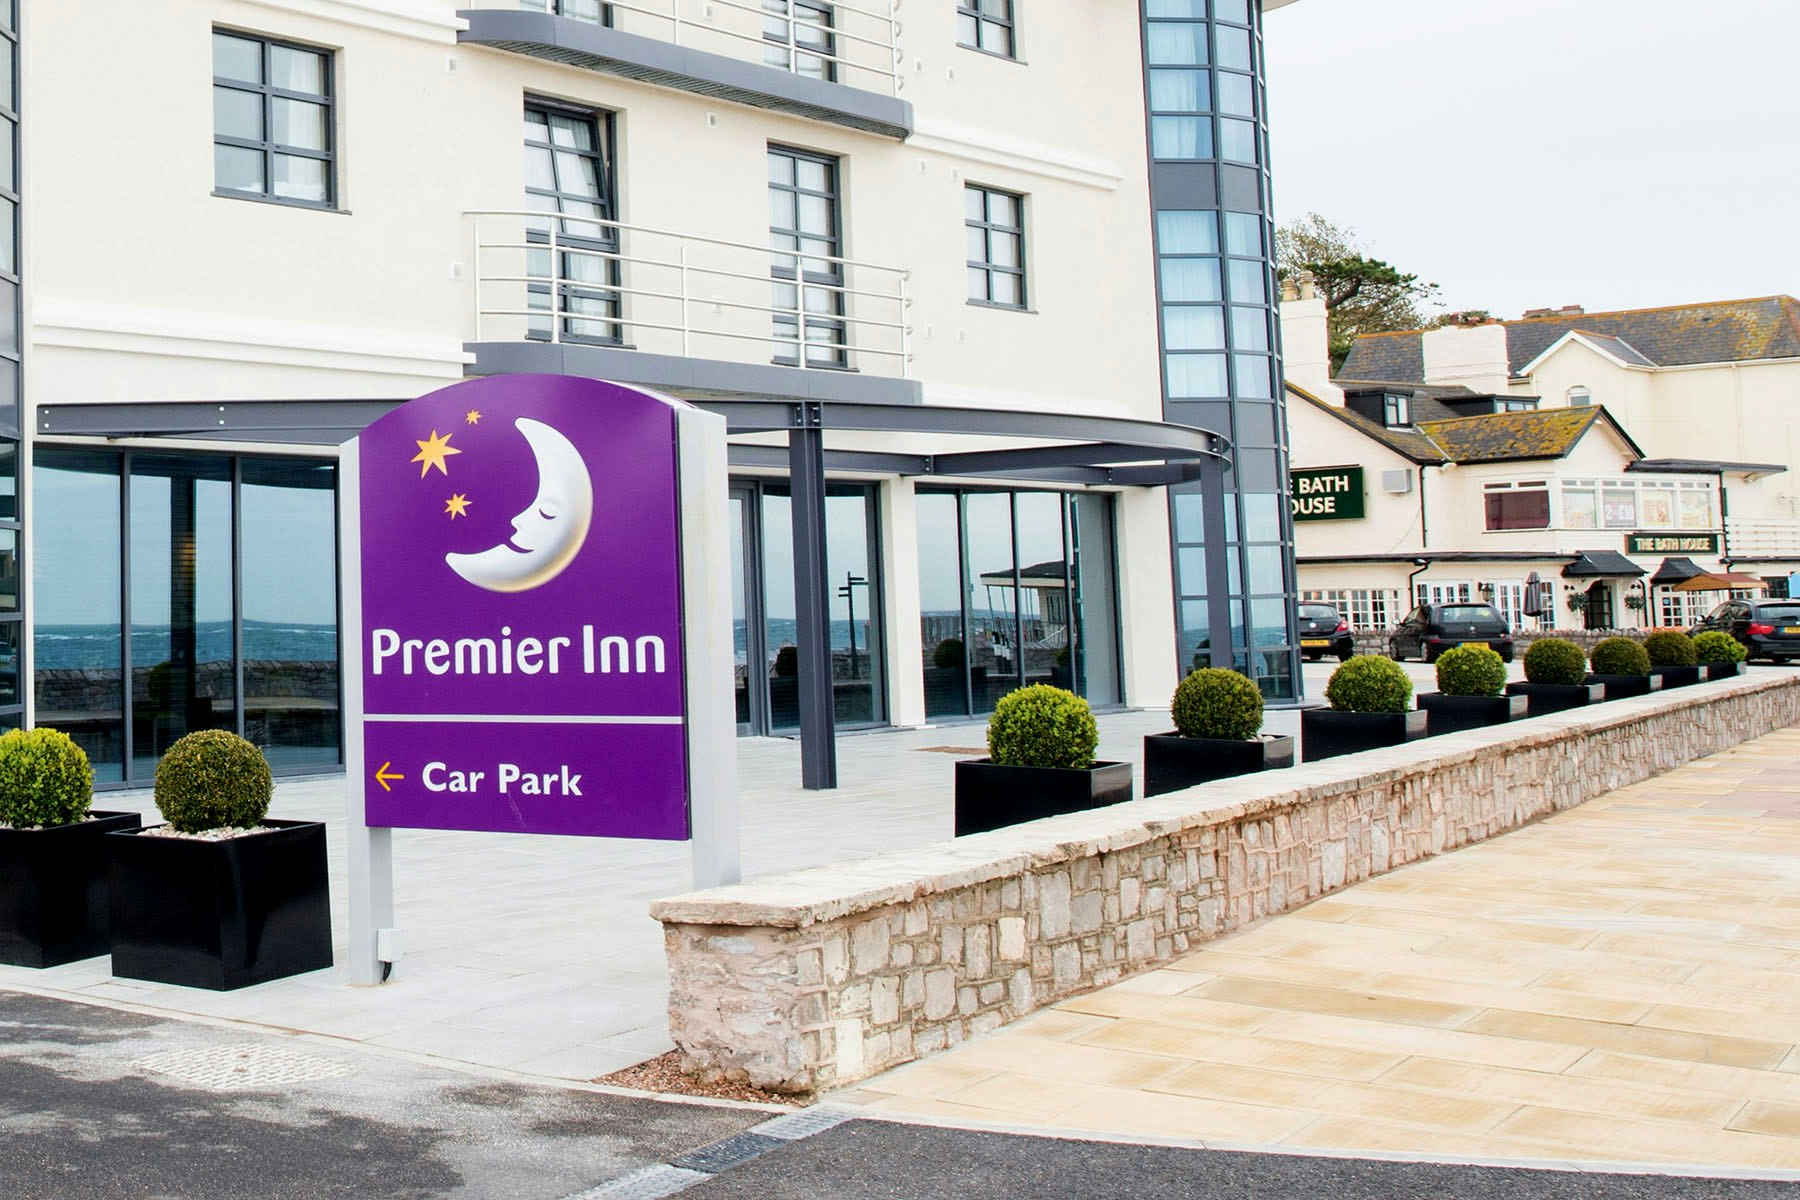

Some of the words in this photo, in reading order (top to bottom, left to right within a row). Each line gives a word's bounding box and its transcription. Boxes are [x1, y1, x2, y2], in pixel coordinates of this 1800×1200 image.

[1298, 475, 1349, 494] BATH
[1290, 496, 1336, 515] OUSE
[1634, 538, 1654, 551] THE
[1655, 538, 1679, 551] BATH
[1679, 538, 1710, 550] HOUSE
[372, 626, 571, 675] Premier
[582, 624, 666, 674] Inn
[421, 761, 485, 793] Car
[499, 763, 583, 796] Park
